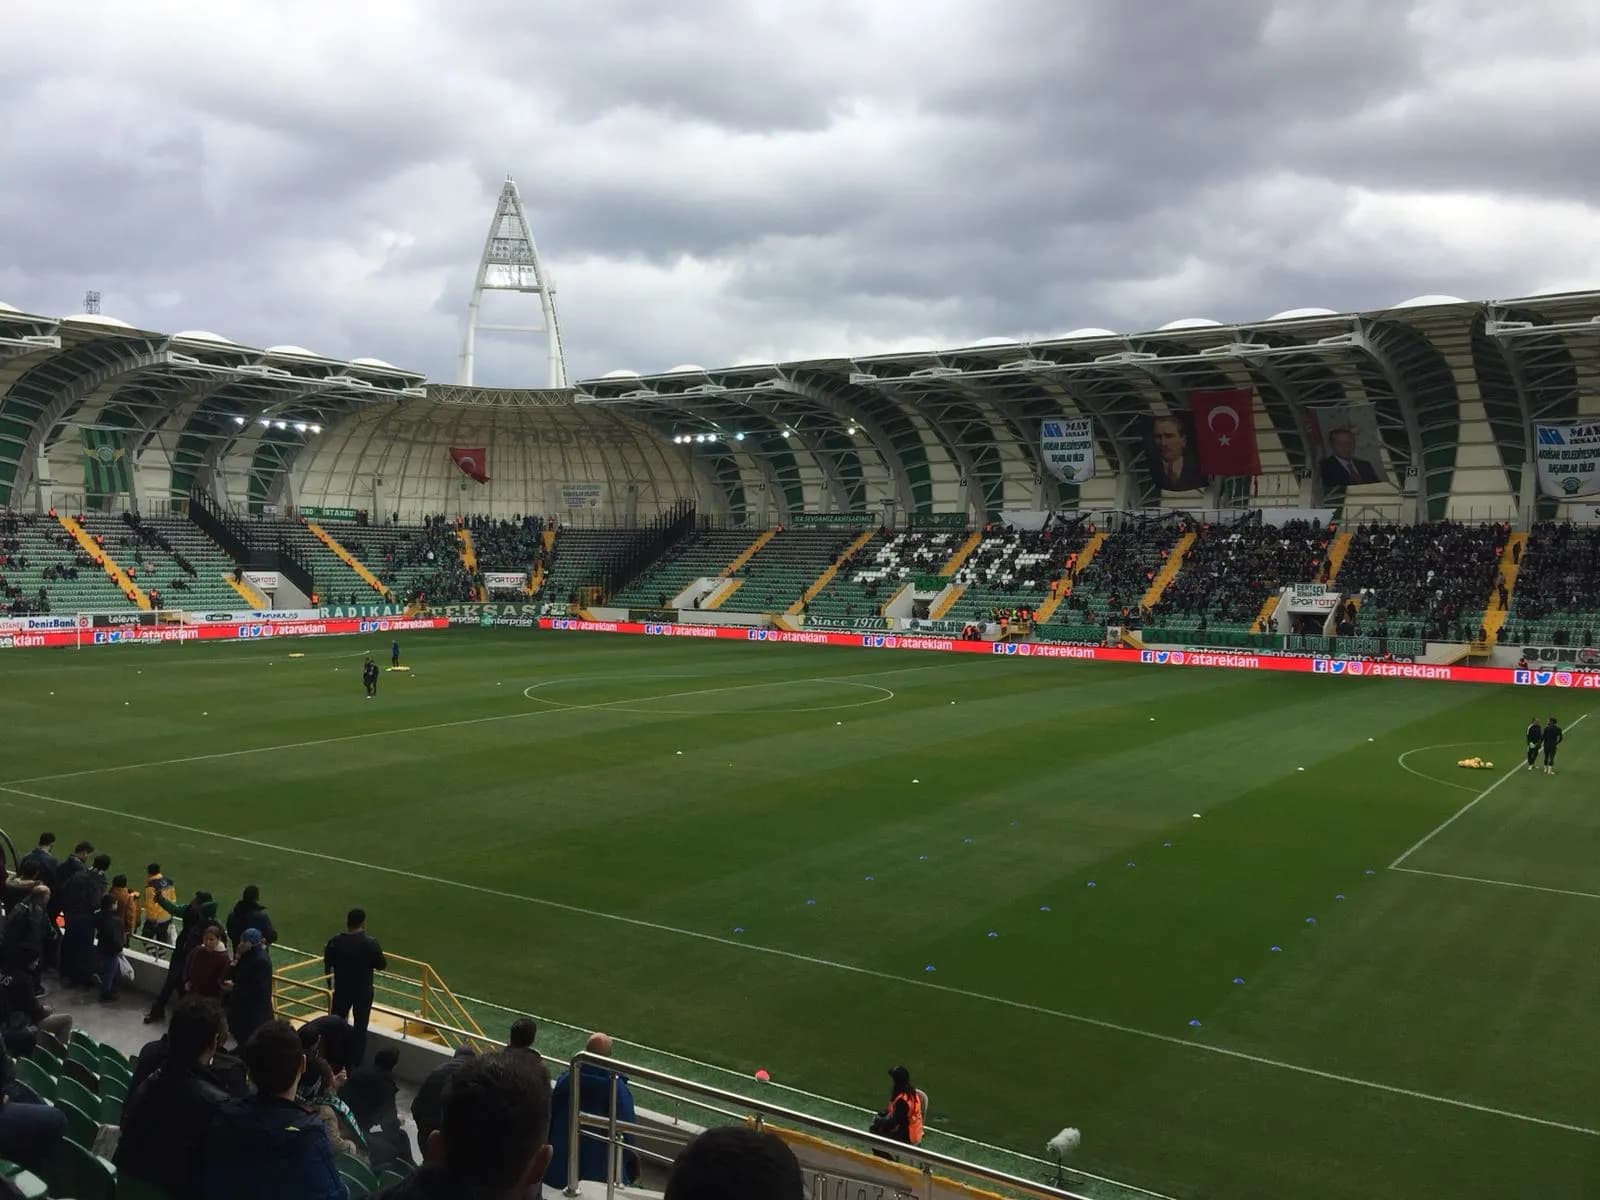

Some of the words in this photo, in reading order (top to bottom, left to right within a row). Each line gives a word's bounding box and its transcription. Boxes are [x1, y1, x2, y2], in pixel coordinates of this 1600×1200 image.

[28, 618, 77, 629] DenizBank
[808, 615, 849, 627] Since
[852, 617, 884, 629] 1970
